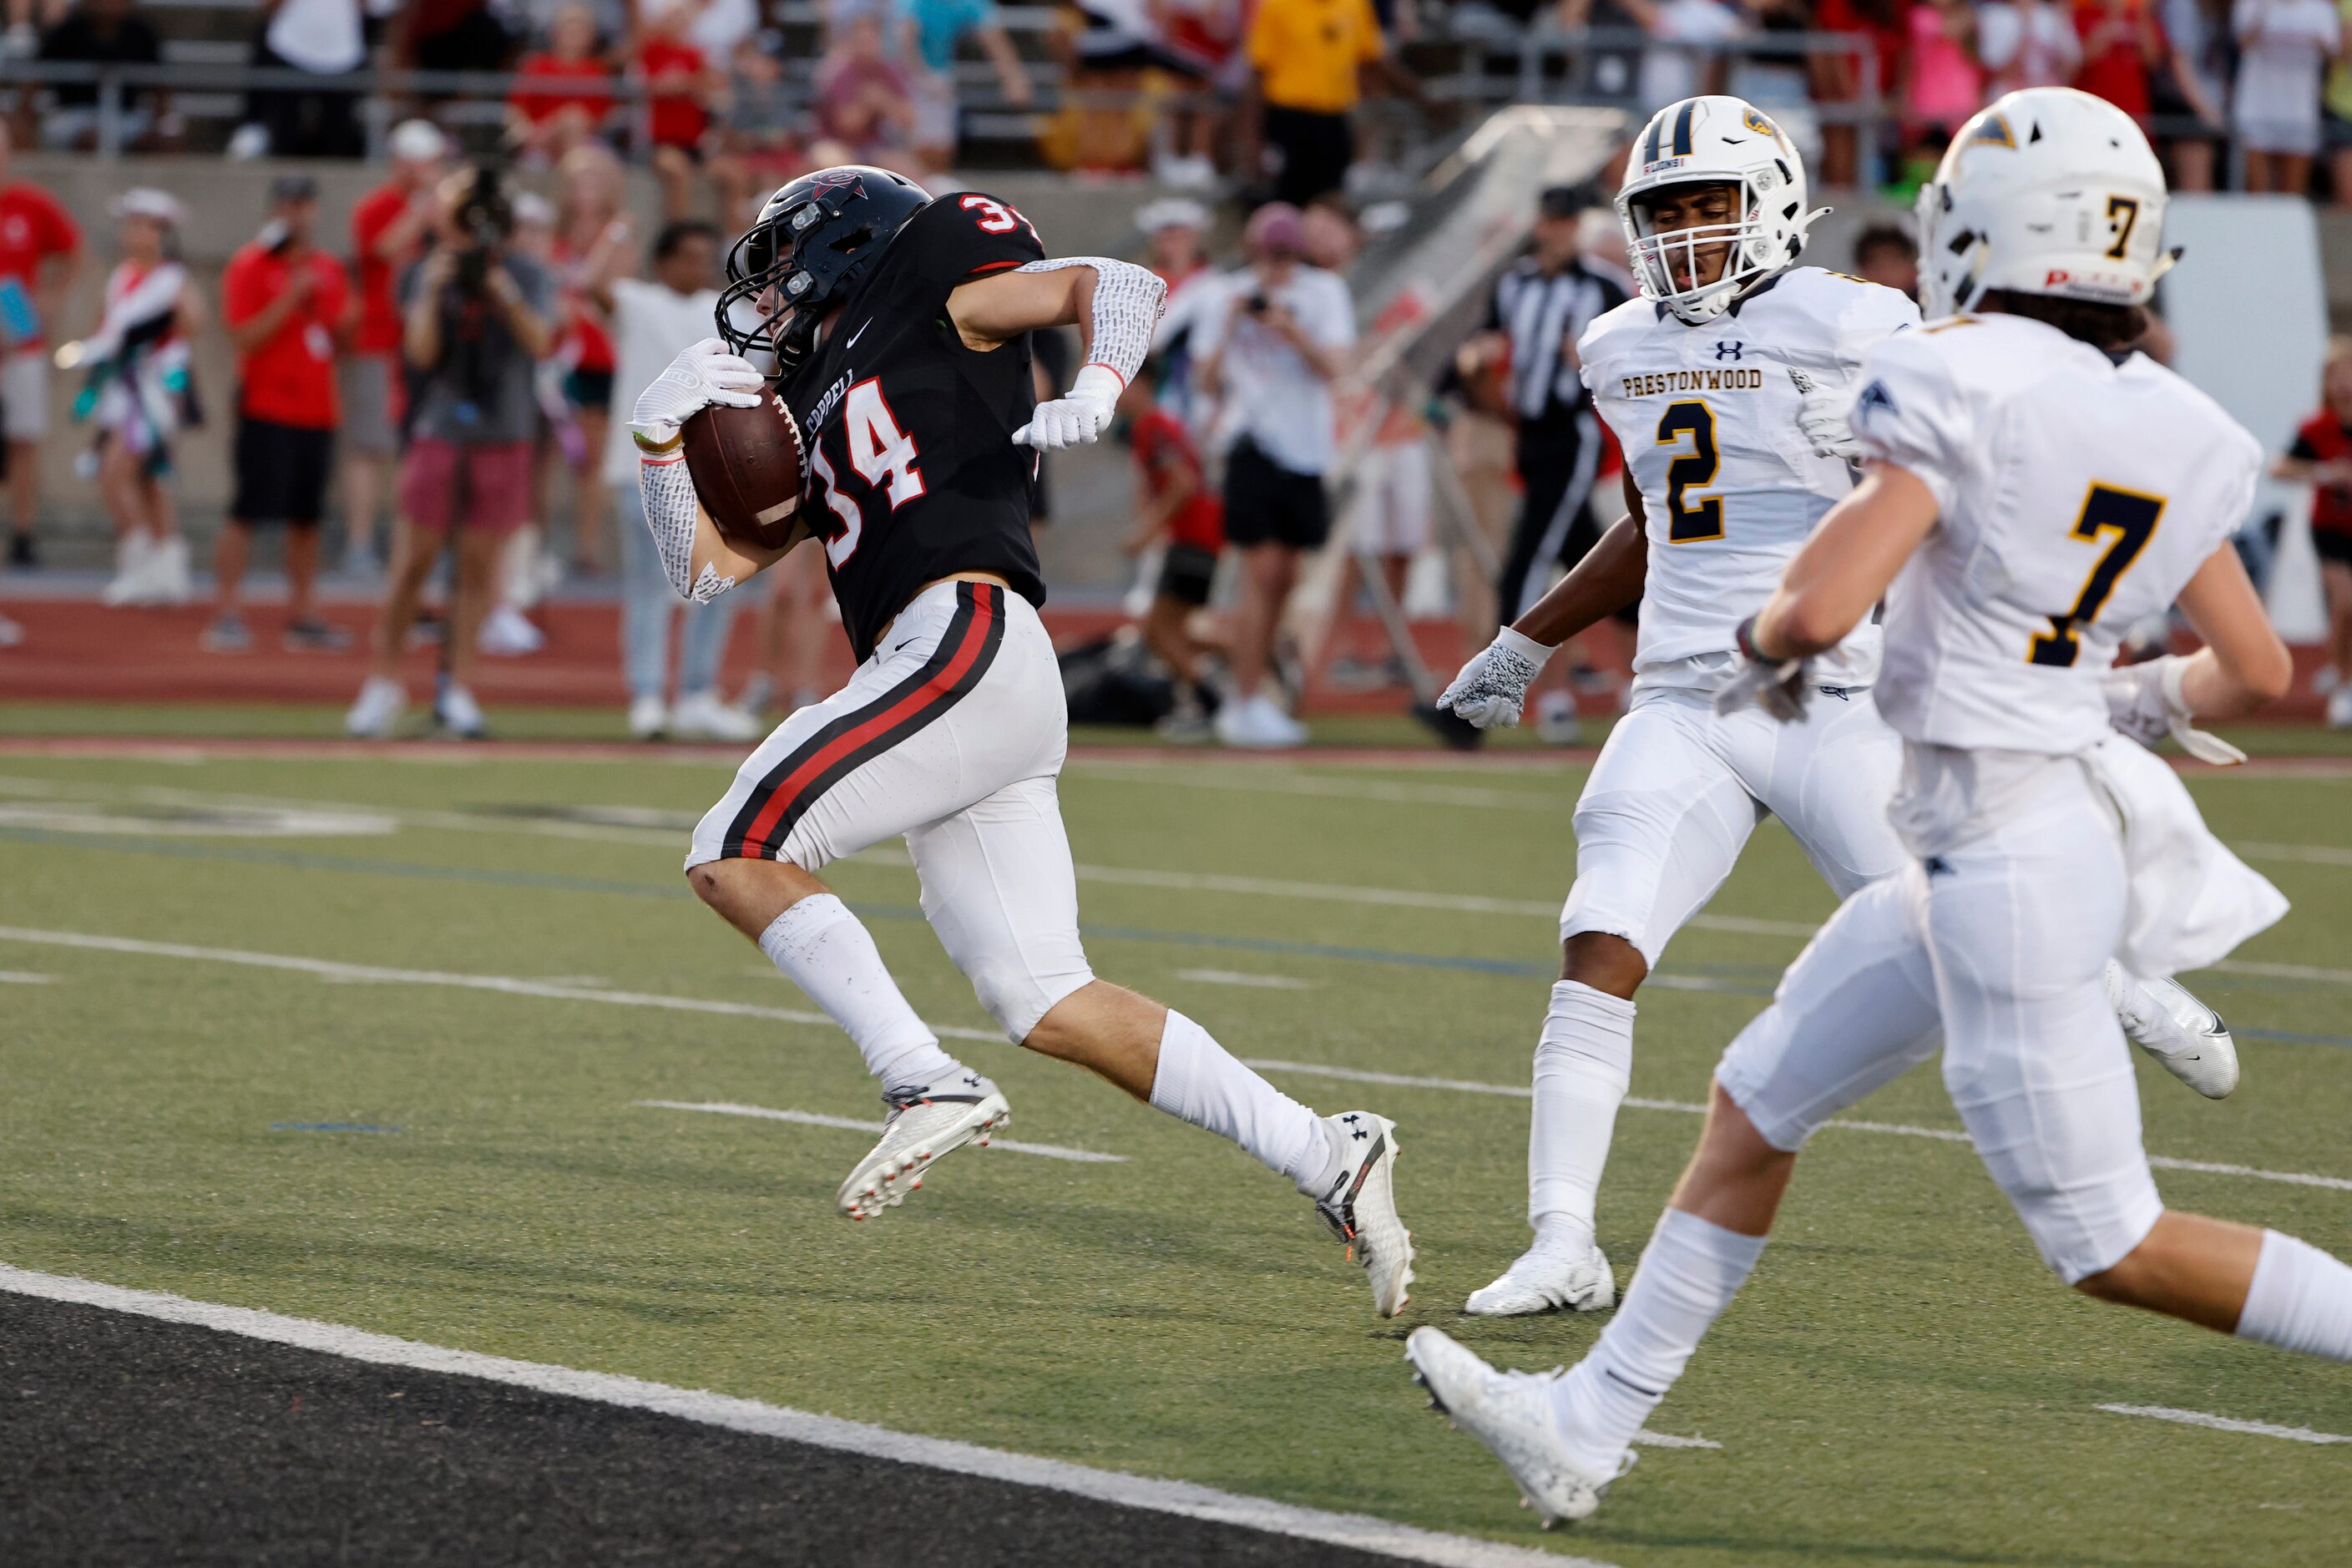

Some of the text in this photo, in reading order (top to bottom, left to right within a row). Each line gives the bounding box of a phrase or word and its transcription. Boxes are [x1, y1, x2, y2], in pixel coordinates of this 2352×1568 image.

[2106, 196, 2140, 260] 7
[806, 368, 856, 442] COPPELL
[1622, 369, 1762, 398] PRESTONWOOD
[805, 375, 928, 574] 34
[1657, 398, 1726, 544] 2
[2024, 478, 2169, 667] 7
